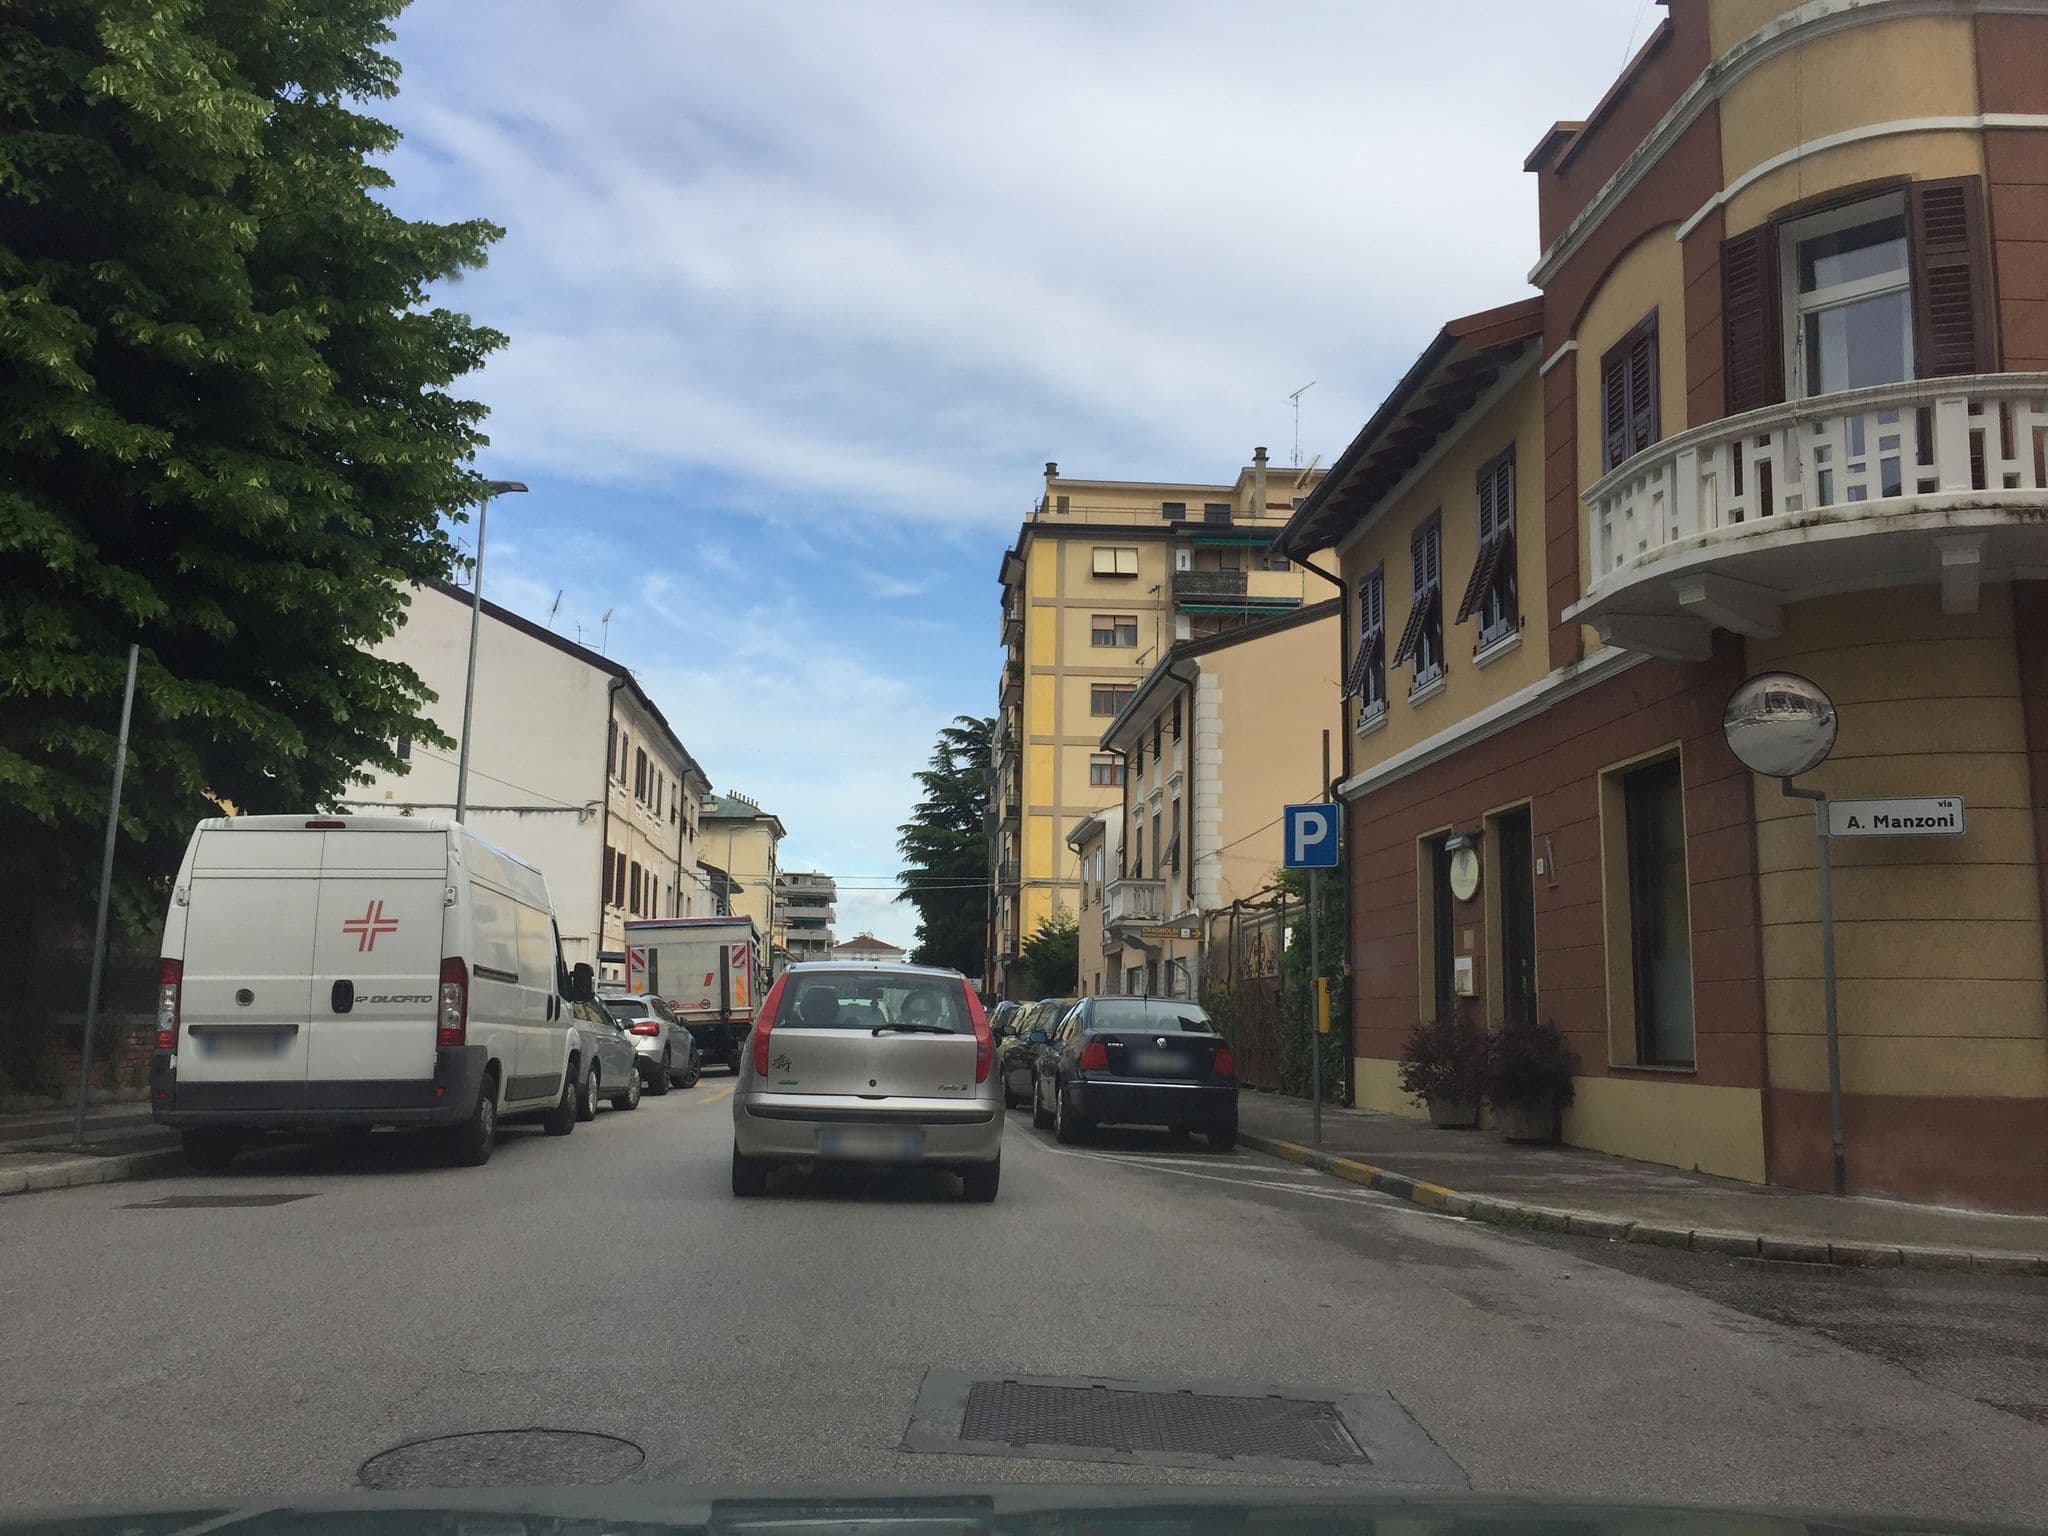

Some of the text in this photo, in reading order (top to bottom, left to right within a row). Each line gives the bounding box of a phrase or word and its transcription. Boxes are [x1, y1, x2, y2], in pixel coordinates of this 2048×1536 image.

[1937, 799, 1953, 808] via
[1847, 813, 1955, 830] A. Manzoni
[1294, 811, 1328, 862] P
[370, 995, 432, 1003] DUCATO
